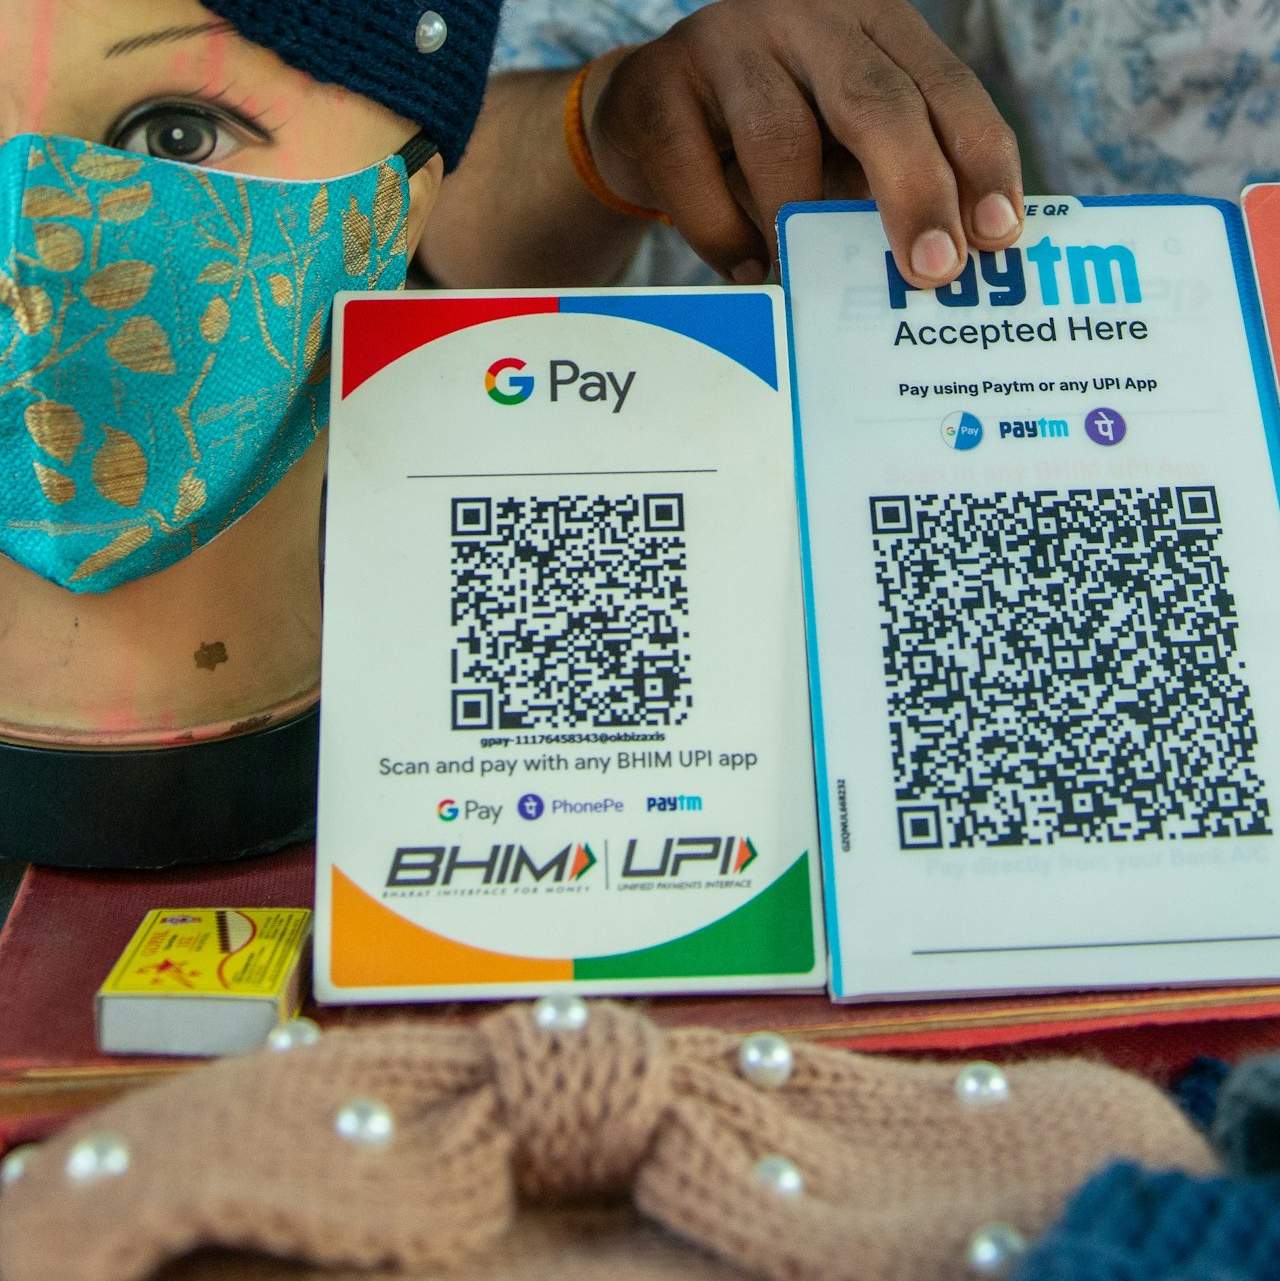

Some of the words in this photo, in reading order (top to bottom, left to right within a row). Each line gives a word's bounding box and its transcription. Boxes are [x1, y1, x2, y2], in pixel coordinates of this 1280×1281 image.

[1043, 204, 1070, 216] QR
[894, 317, 1057, 350] Accepted
[1068, 316, 1148, 341] Here
[549, 359, 637, 414] Pay
[899, 383, 929, 398] Pay
[933, 379, 979, 397] using
[982, 380, 1035, 396] Paytm
[1038, 381, 1056, 392] or
[1059, 378, 1089, 394] any
[1092, 377, 1121, 391] UPI
[1124, 377, 1158, 393] App
[960, 426, 980, 437] Pay
[379, 758, 430, 776] Scan
[435, 756, 475, 774] and
[480, 759, 518, 777] pay
[523, 754, 569, 772] with
[574, 756, 611, 774] any
[617, 751, 672, 769] BHIM
[679, 749, 712, 768] UPI
[719, 752, 758, 770] app
[464, 800, 503, 825] Pay
[552, 798, 624, 814] PhonePe
[385, 842, 573, 888] BHIM
[621, 835, 736, 878] UPI
